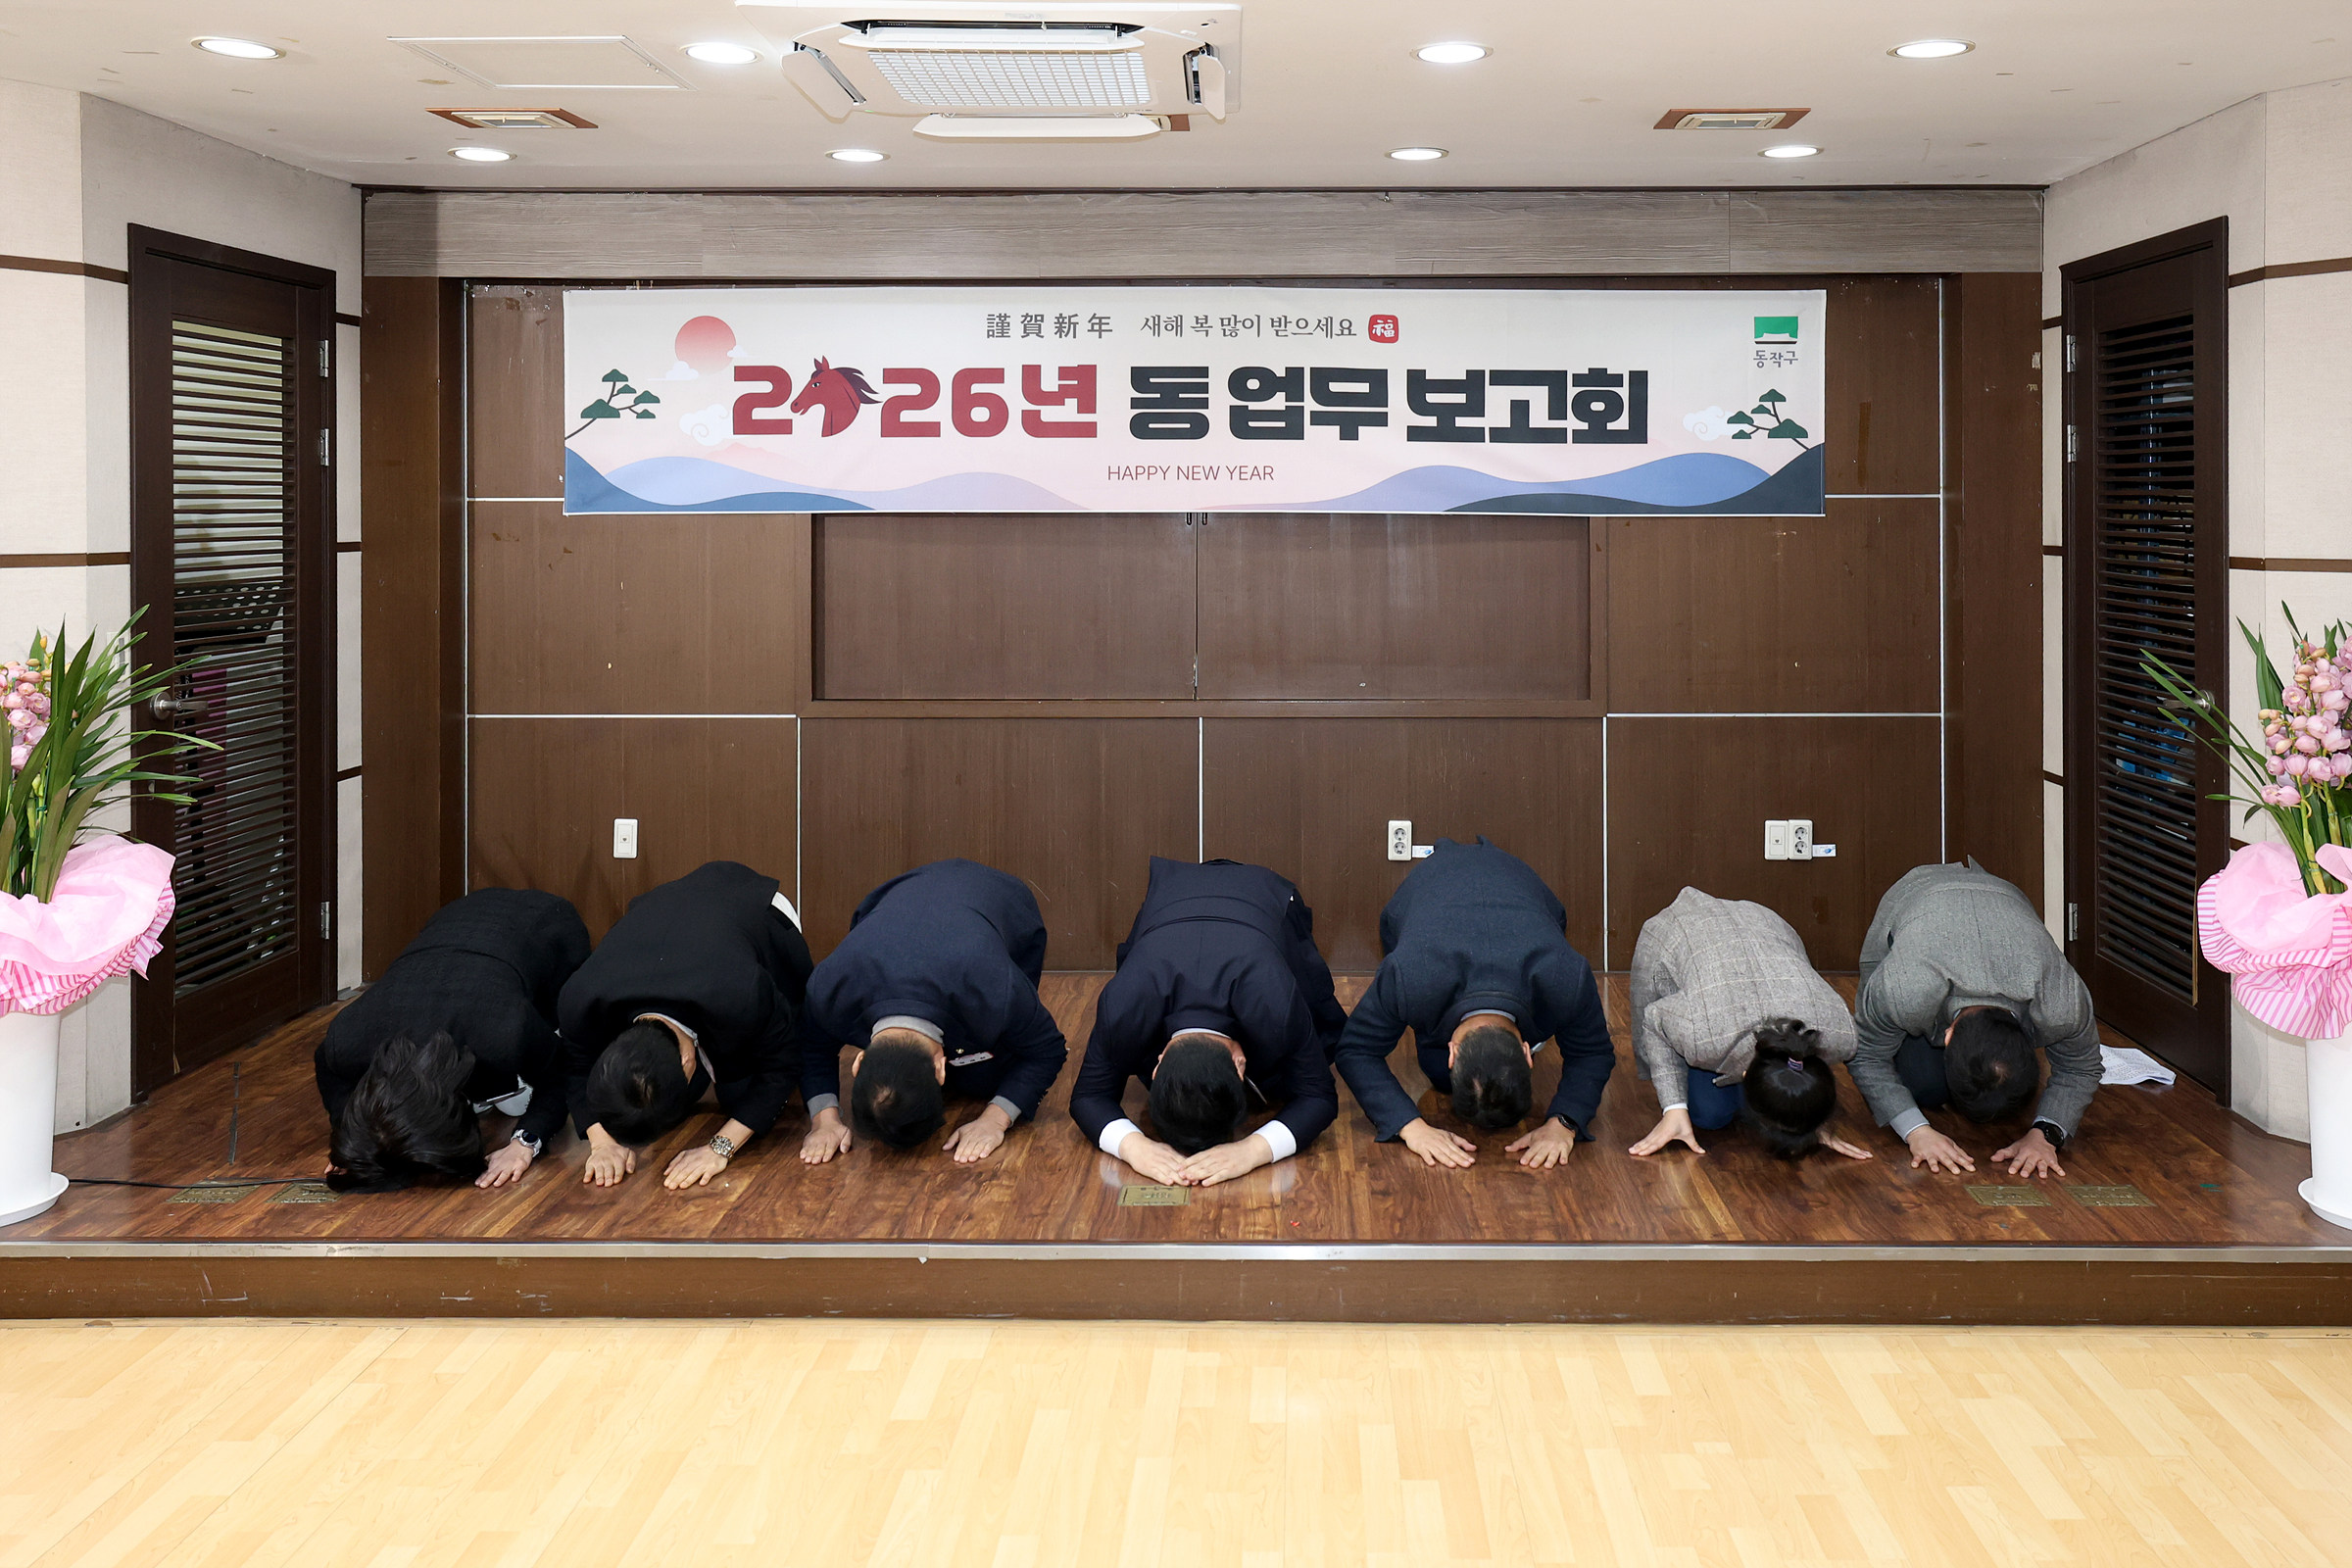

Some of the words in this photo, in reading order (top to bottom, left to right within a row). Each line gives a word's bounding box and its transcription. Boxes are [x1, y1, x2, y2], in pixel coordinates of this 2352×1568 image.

[986, 312, 1113, 339] 謹賀新年
[1140, 314, 1184, 338] 새해
[1189, 315, 1214, 338] 복
[1218, 314, 1261, 339] 많이
[1268, 314, 1357, 339] 받으세요
[1752, 349, 1799, 368] 동작구
[731, 364, 1099, 439] 226년
[1128, 366, 1210, 441] 동
[1227, 367, 1390, 442] 업무
[1405, 368, 1649, 445] 보고회
[1107, 465, 1171, 481] HAPPY
[1176, 465, 1221, 481] NEW
[1225, 465, 1275, 481] YEAR
